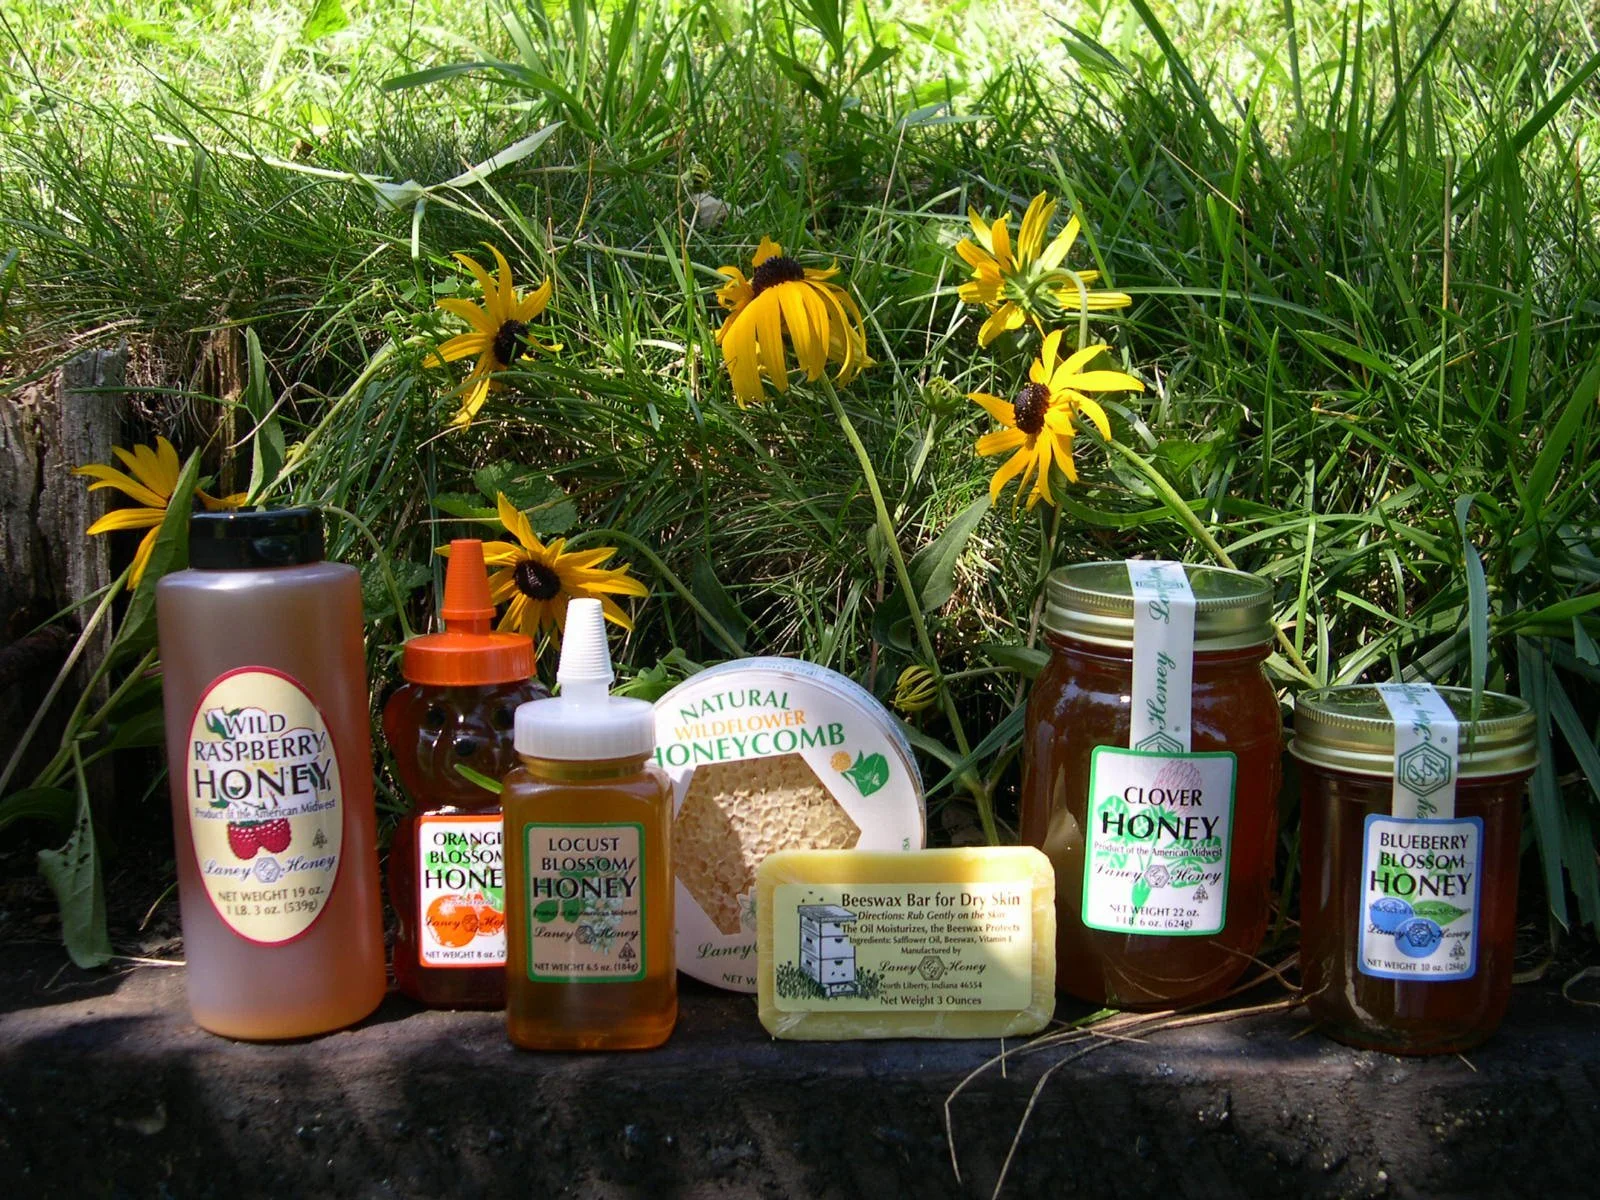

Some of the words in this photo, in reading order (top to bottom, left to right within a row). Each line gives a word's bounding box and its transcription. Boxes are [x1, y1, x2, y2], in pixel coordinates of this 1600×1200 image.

[1146, 651, 1176, 730] Honey
[680, 689, 790, 724] NATURAL
[224, 714, 286, 735] WILD
[675, 710, 806, 740] WILDFLOWER
[194, 732, 325, 761] RASPBERRY
[194, 759, 332, 800] HONEY
[1124, 786, 1202, 806] CLOVER
[255, 804, 299, 818] American
[301, 799, 336, 813] Midwest
[1102, 811, 1219, 840] HONEY
[548, 838, 620, 852] LOCUST
[1380, 832, 1469, 850] BLUEBERRY
[1094, 842, 1124, 853] Product
[1126, 846, 1135, 855] of
[1136, 846, 1149, 855] the
[1151, 847, 1189, 857] American
[1191, 848, 1223, 857] Midwest
[204, 859, 252, 880] Laney
[283, 855, 337, 873] Honey
[542, 857, 628, 872] BLOSSOM
[1380, 852, 1465, 870] BLOSSOM
[425, 869, 503, 889] HONE
[1095, 863, 1142, 882] Laney
[1171, 867, 1222, 885] Honey
[533, 877, 637, 899] HONEY
[1370, 870, 1472, 897] HONEY
[218, 891, 237, 902] NET
[241, 888, 288, 902] WEIGHT
[293, 888, 305, 898] 19
[308, 886, 324, 896] oz.
[842, 893, 901, 907] Beeswax
[907, 893, 931, 907] Bar
[936, 892, 956, 907] for
[960, 893, 985, 909] Dry
[992, 892, 1021, 906] Skin
[235, 905, 251, 915] LB.
[255, 906, 261, 915] 3
[264, 907, 280, 915] oz.
[284, 900, 318, 914] (539g)
[1109, 904, 1127, 913] NET
[1130, 905, 1169, 917] WEIGHT
[1173, 907, 1184, 917] 22
[1186, 909, 1200, 917] oz.
[858, 911, 905, 920] Directions:
[907, 911, 924, 920] Rub
[927, 911, 955, 922] Gently
[971, 911, 985, 920] the
[1140, 918, 1145, 926] 6
[1164, 919, 1193, 930] (624g)
[533, 927, 575, 942] Laney
[596, 928, 639, 942] Honey
[842, 924, 858, 934] The
[860, 924, 874, 934] Oil
[877, 924, 928, 934] Moisturizes,
[931, 924, 945, 933] the
[947, 924, 983, 933] Beeswax
[985, 924, 1021, 933] Protects
[1368, 924, 1406, 940] Laney
[1434, 928, 1471, 941] Honey
[849, 937, 890, 946] Ingredients:
[893, 936, 926, 944] Safflower
[928, 936, 942, 945] Oil,
[944, 936, 977, 945] Beeswax,
[979, 935, 1007, 943] Vitamin
[442, 951, 475, 959] WEIGHT
[696, 942, 752, 960] Laney
[900, 947, 951, 955] Manufactured
[953, 946, 962, 956] by
[534, 963, 549, 971] NET
[552, 963, 585, 971] WEIGHT
[878, 960, 918, 975] Laney
[945, 960, 987, 976] Honey
[1367, 958, 1382, 968] NET
[1385, 960, 1417, 971] WEIGHT
[722, 972, 743, 983] NET
[880, 982, 901, 990] North
[903, 982, 929, 991] Liberty,
[931, 982, 958, 990] Indiana
[880, 995, 898, 1005] Net
[900, 995, 935, 1007] Weight
[938, 996, 944, 1005] 3
[946, 995, 983, 1005] Ounces
